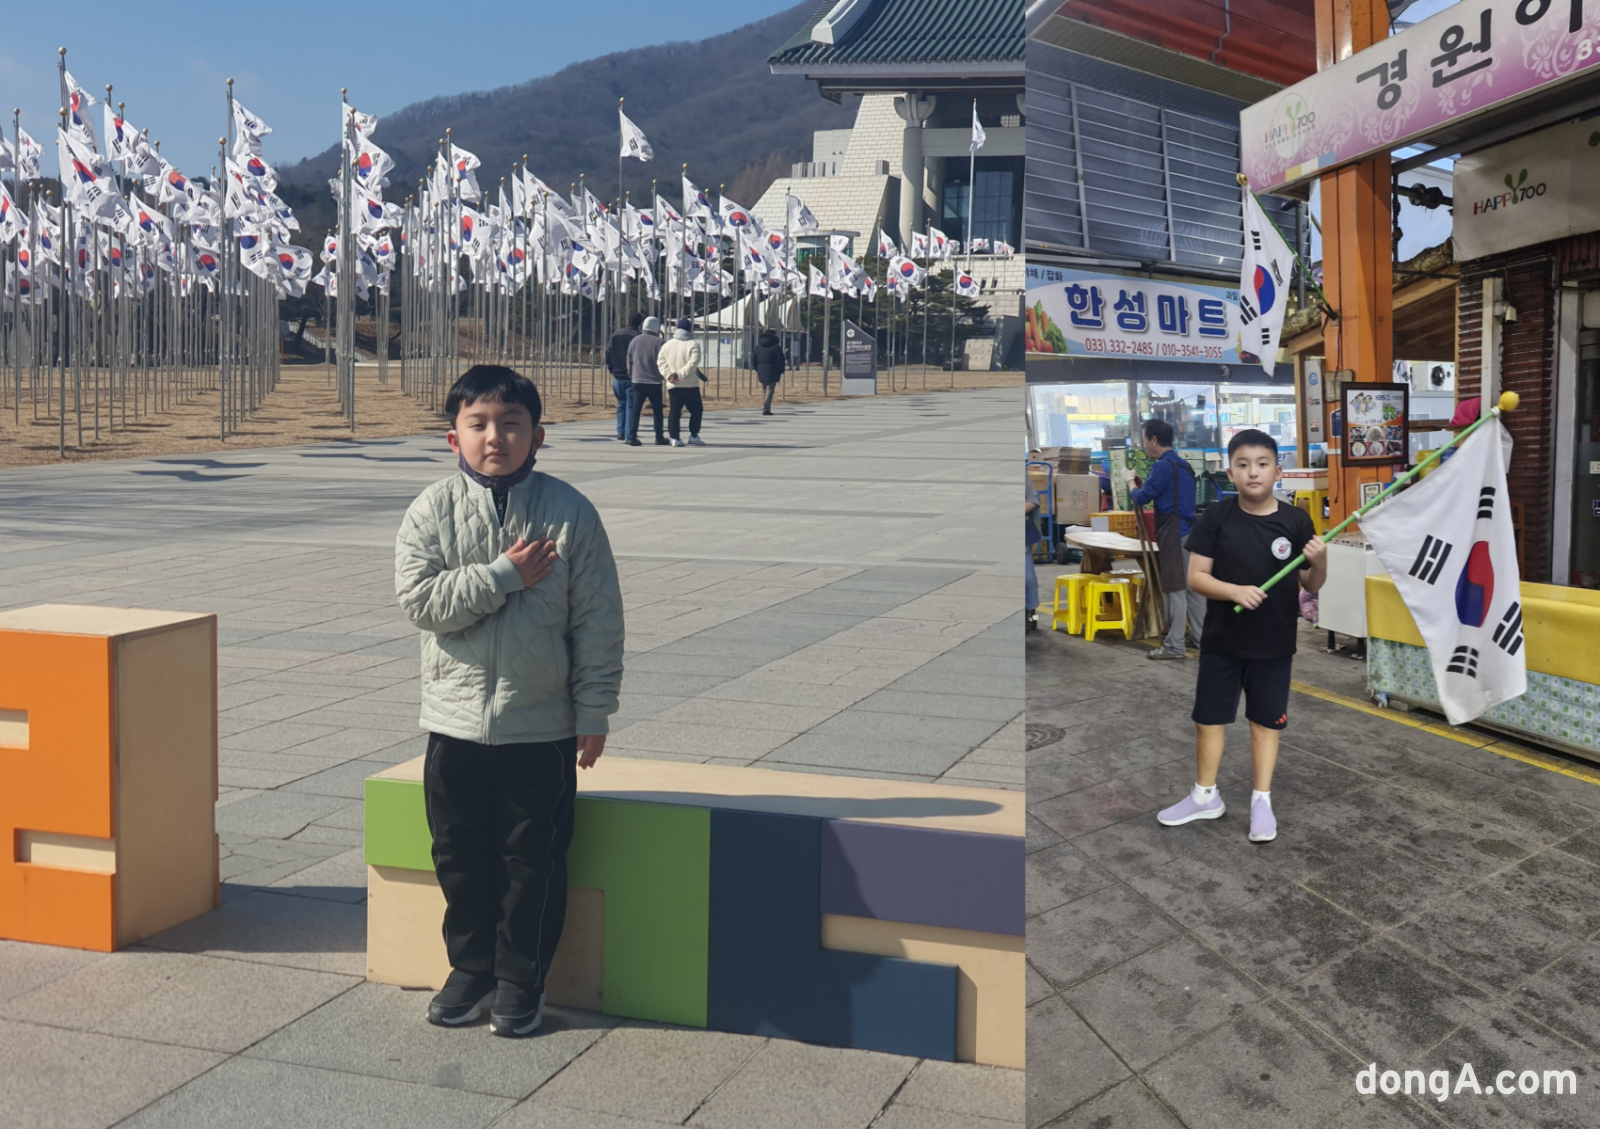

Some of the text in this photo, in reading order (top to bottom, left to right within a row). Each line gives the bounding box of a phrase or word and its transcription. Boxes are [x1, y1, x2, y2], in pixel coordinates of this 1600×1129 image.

[1046, 269, 1063, 282] 잡화
[1064, 283, 1227, 337] 한성마트
[1085, 337, 1107, 355] 033)
[1109, 340, 1153, 356] 332-2485
[1161, 343, 1223, 359] 010-3541-3055
